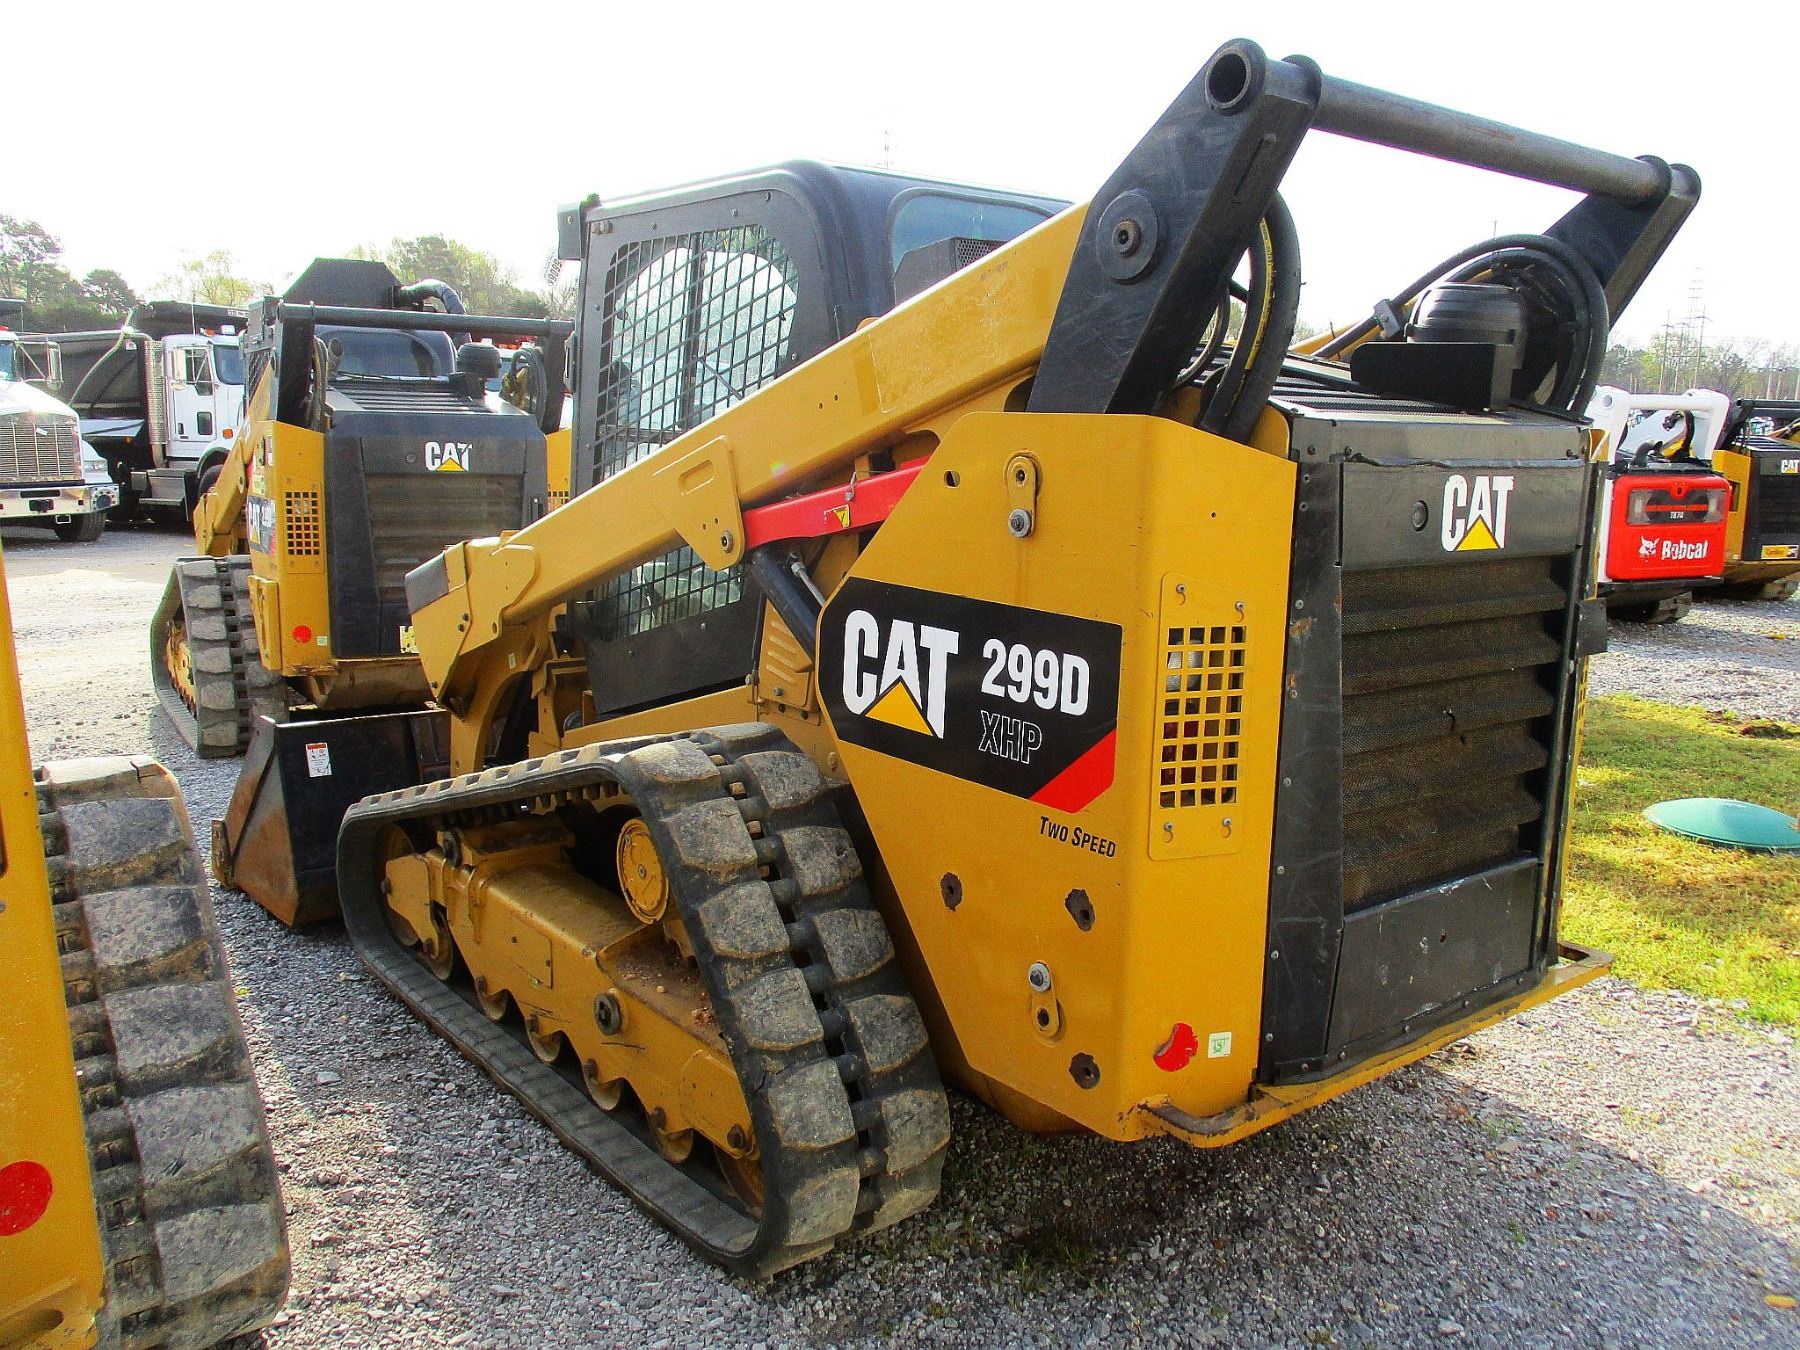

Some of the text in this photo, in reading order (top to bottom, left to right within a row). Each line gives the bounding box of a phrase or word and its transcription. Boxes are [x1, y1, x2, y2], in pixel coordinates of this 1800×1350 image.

[425, 441, 473, 471] CAT
[1781, 459, 1800, 473] CAT
[1441, 474, 1514, 552] CAT
[1661, 539, 1708, 560] Bobcat
[843, 609, 1090, 740] CAT 299D
[978, 710, 1043, 764] XHP
[1040, 816, 1116, 857] TWO SPEED
